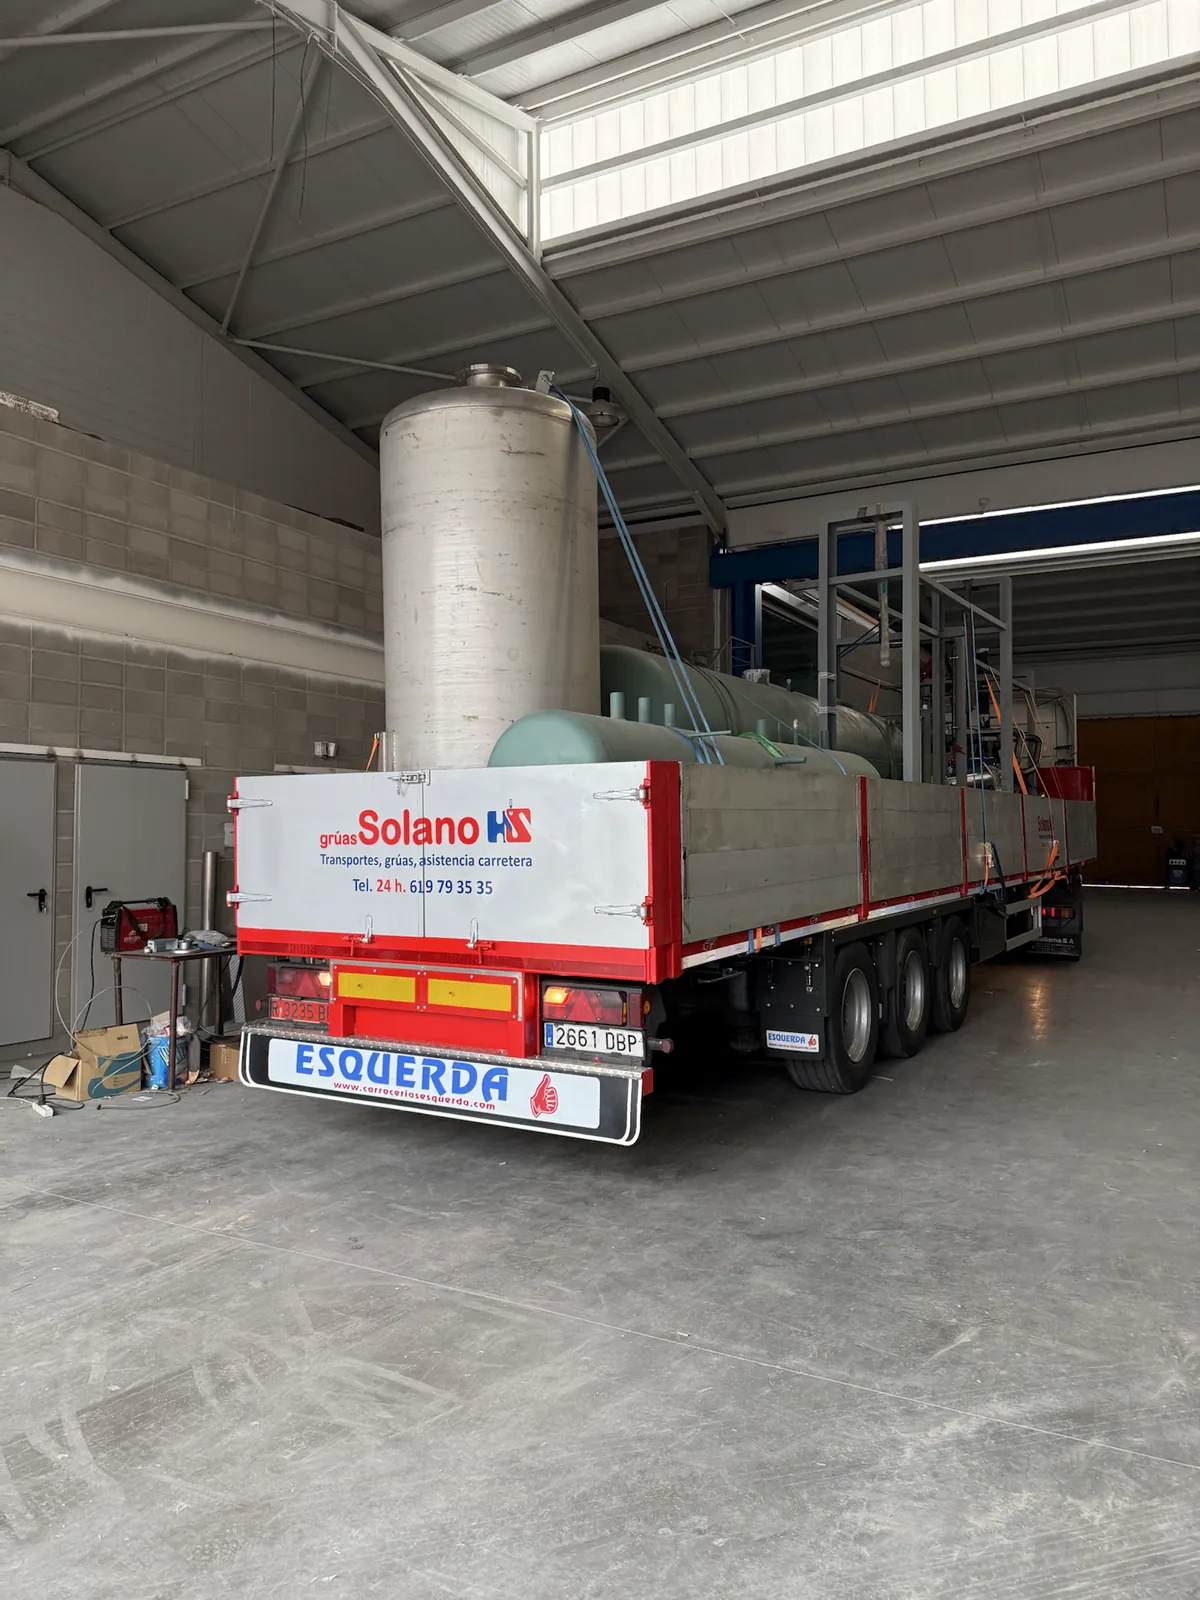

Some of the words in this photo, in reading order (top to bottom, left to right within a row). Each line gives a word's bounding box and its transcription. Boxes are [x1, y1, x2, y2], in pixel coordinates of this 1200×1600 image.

[320, 830, 357, 848] grúas
[358, 809, 480, 845] Solano
[320, 853, 382, 867] Transportes,
[384, 854, 417, 869] grúas,
[419, 854, 475, 867] asistencia
[478, 856, 533, 867] carretera
[353, 878, 373, 892] Tel.
[376, 878, 391, 893] 24
[395, 878, 406, 893] h.
[409, 879, 433, 894] 619
[437, 880, 453, 894] 79
[456, 880, 472, 894] 35
[476, 880, 493, 895] 35
[283, 1001, 314, 1020] 3235
[556, 1027, 597, 1049] 2661
[605, 1031, 637, 1053] DBP
[768, 1033, 806, 1044] ESQUERDA
[295, 1043, 509, 1103] ESQUERDA
[333, 1081, 496, 1111] www.carroceriasesquerda.com
